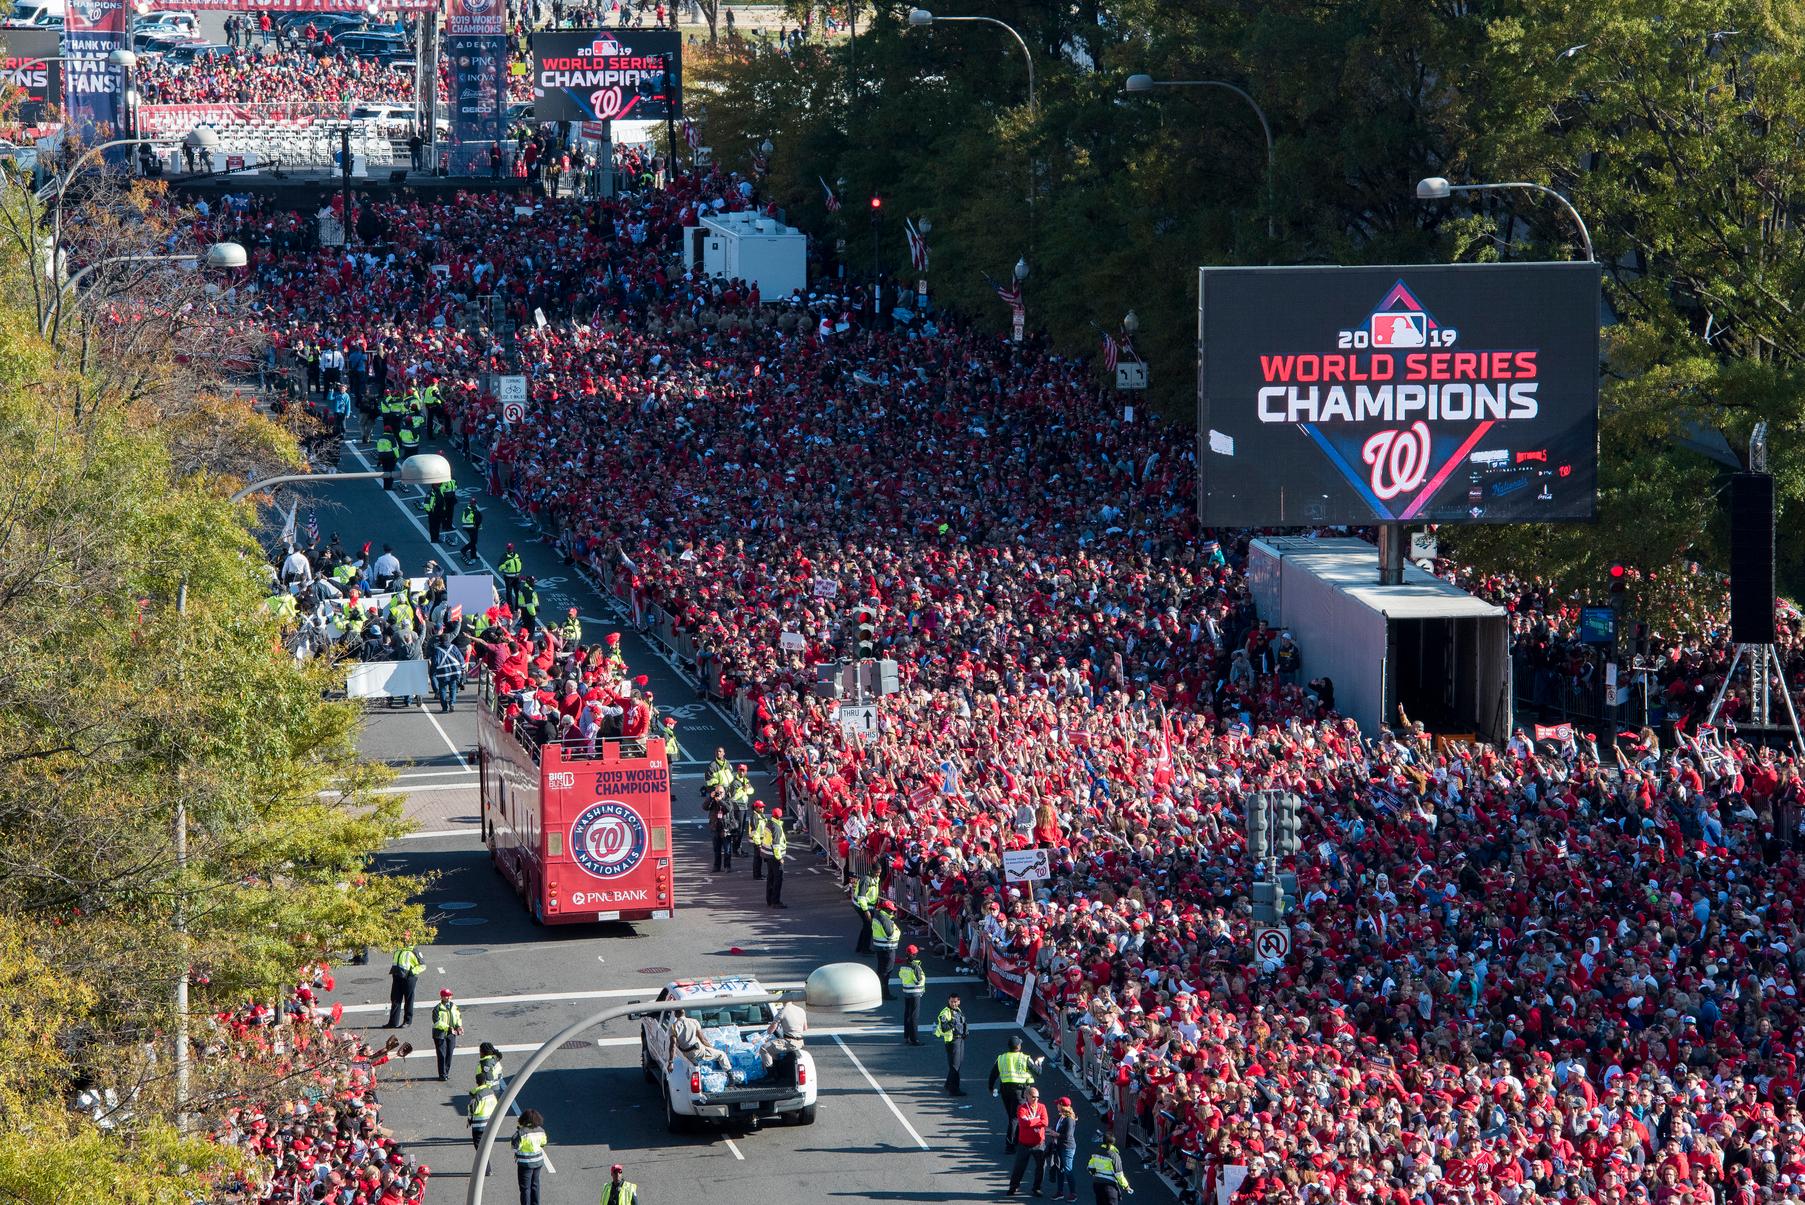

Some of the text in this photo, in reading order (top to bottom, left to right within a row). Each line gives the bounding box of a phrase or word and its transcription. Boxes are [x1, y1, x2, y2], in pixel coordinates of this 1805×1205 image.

[450, 15, 503, 24] 2019 WORLD
[451, 24, 502, 33] CHAMPIONS
[65, 40, 120, 51] THANK YOU
[466, 41, 498, 49] DELTA
[577, 47, 633, 56] 20 19
[471, 56, 496, 66] PNC
[542, 57, 604, 70] WORLD
[467, 73, 495, 81] INOVA
[67, 74, 121, 94] FANS!
[1338, 329, 1457, 349] 20 19
[1260, 351, 1538, 382] WORLD SERIES
[1257, 382, 1539, 423] CHAMPIONS
[842, 709, 860, 717] THRU
[548, 773, 563, 781] BIG
[595, 768, 667, 783] 2019 WORLD
[595, 781, 668, 796] CHAMPIONS
[575, 805, 642, 834] WASHINGTON
[578, 851, 640, 875] NATIONALS
